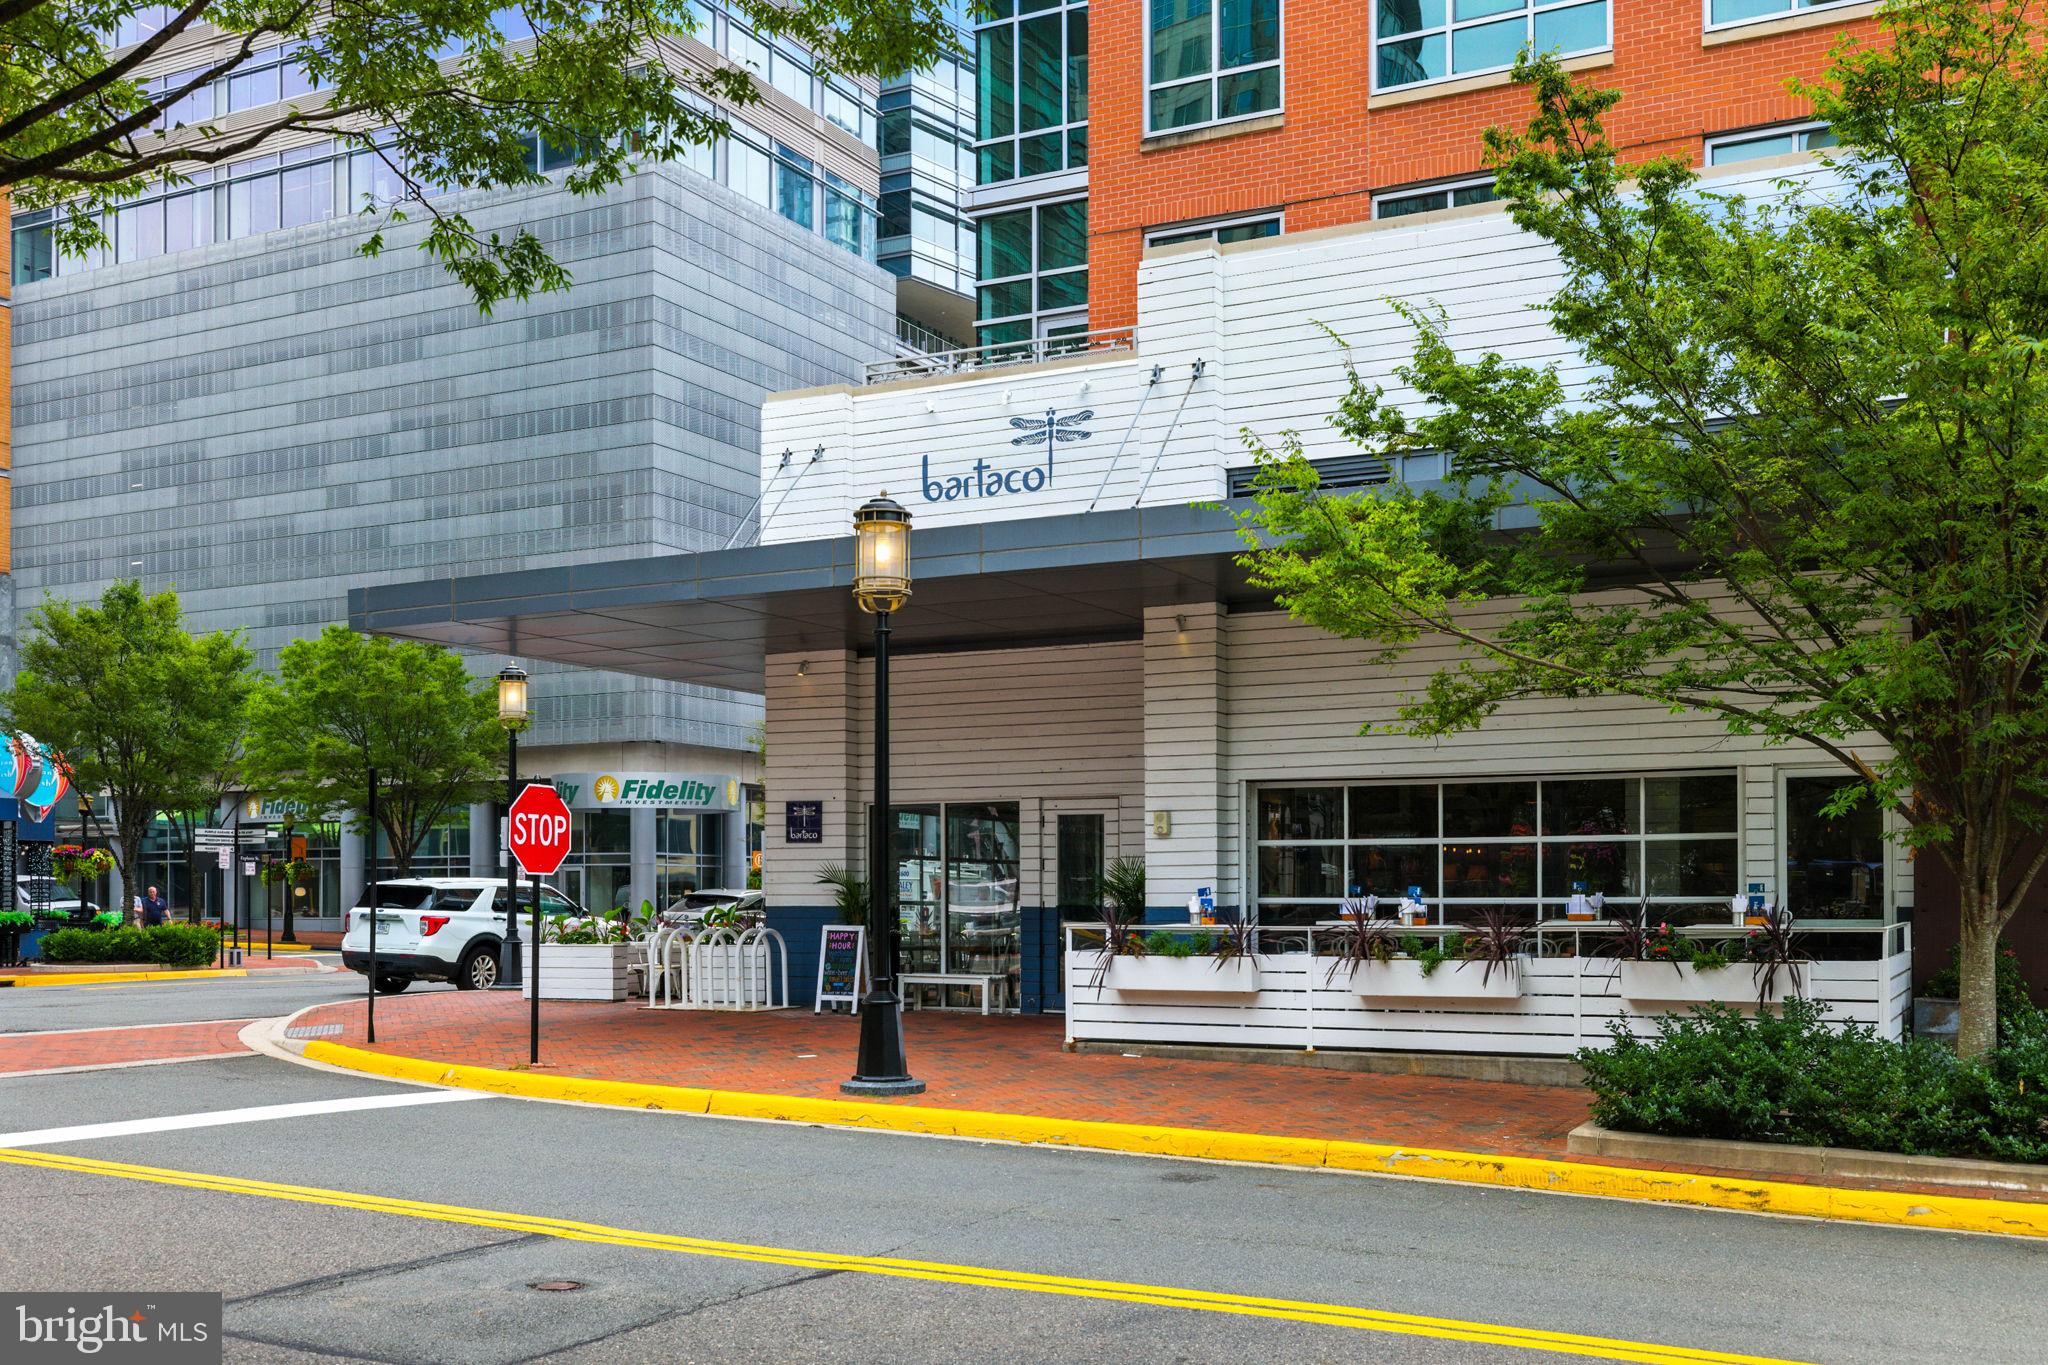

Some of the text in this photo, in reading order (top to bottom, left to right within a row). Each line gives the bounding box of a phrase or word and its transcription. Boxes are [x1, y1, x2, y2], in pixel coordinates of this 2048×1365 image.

[922, 454, 1045, 501] bartaco
[556, 781, 579, 804] lity
[622, 779, 716, 806] Fidelity
[514, 812, 567, 847] STOP
[790, 827, 818, 839] bartaco
[830, 932, 855, 940] HAPPY
[831, 942, 852, 950] HOUR
